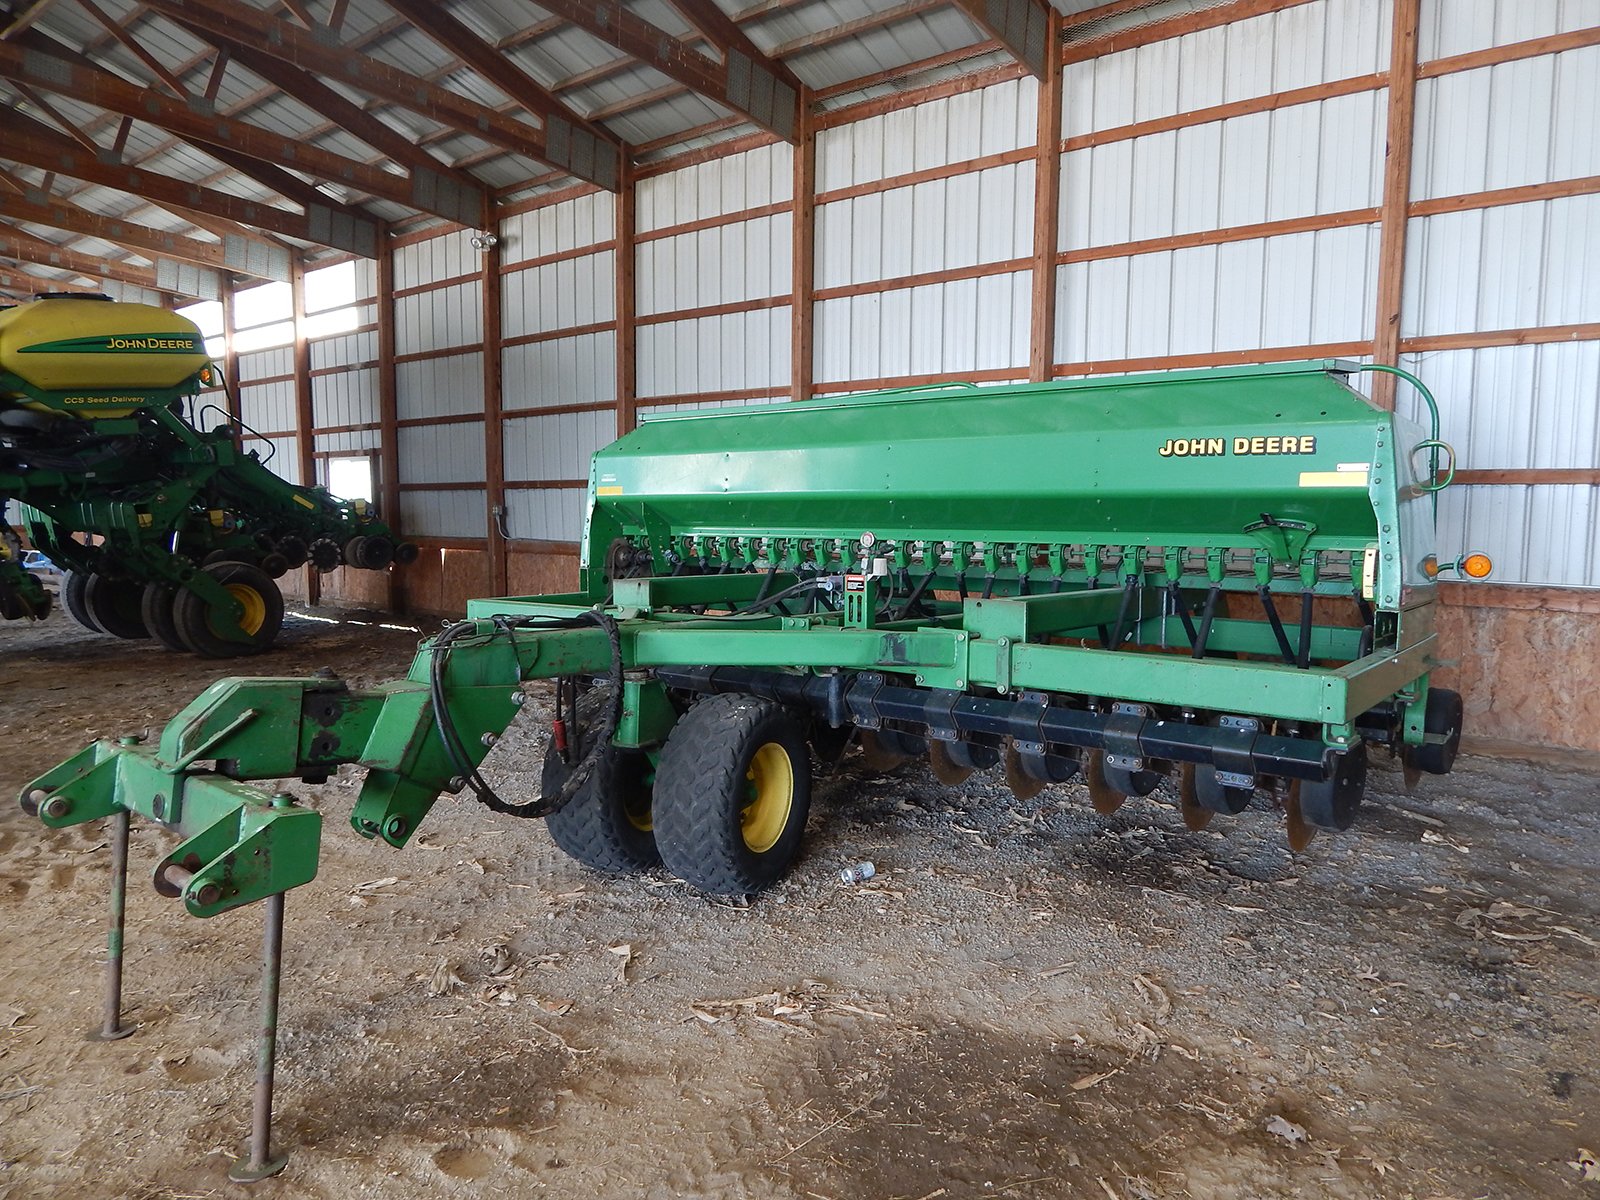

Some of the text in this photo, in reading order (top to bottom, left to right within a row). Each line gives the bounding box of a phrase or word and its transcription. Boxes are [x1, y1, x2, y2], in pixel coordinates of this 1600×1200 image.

[106, 338, 194, 349] JOHN DEERE
[1159, 436, 1316, 457] JOHN DEERE
